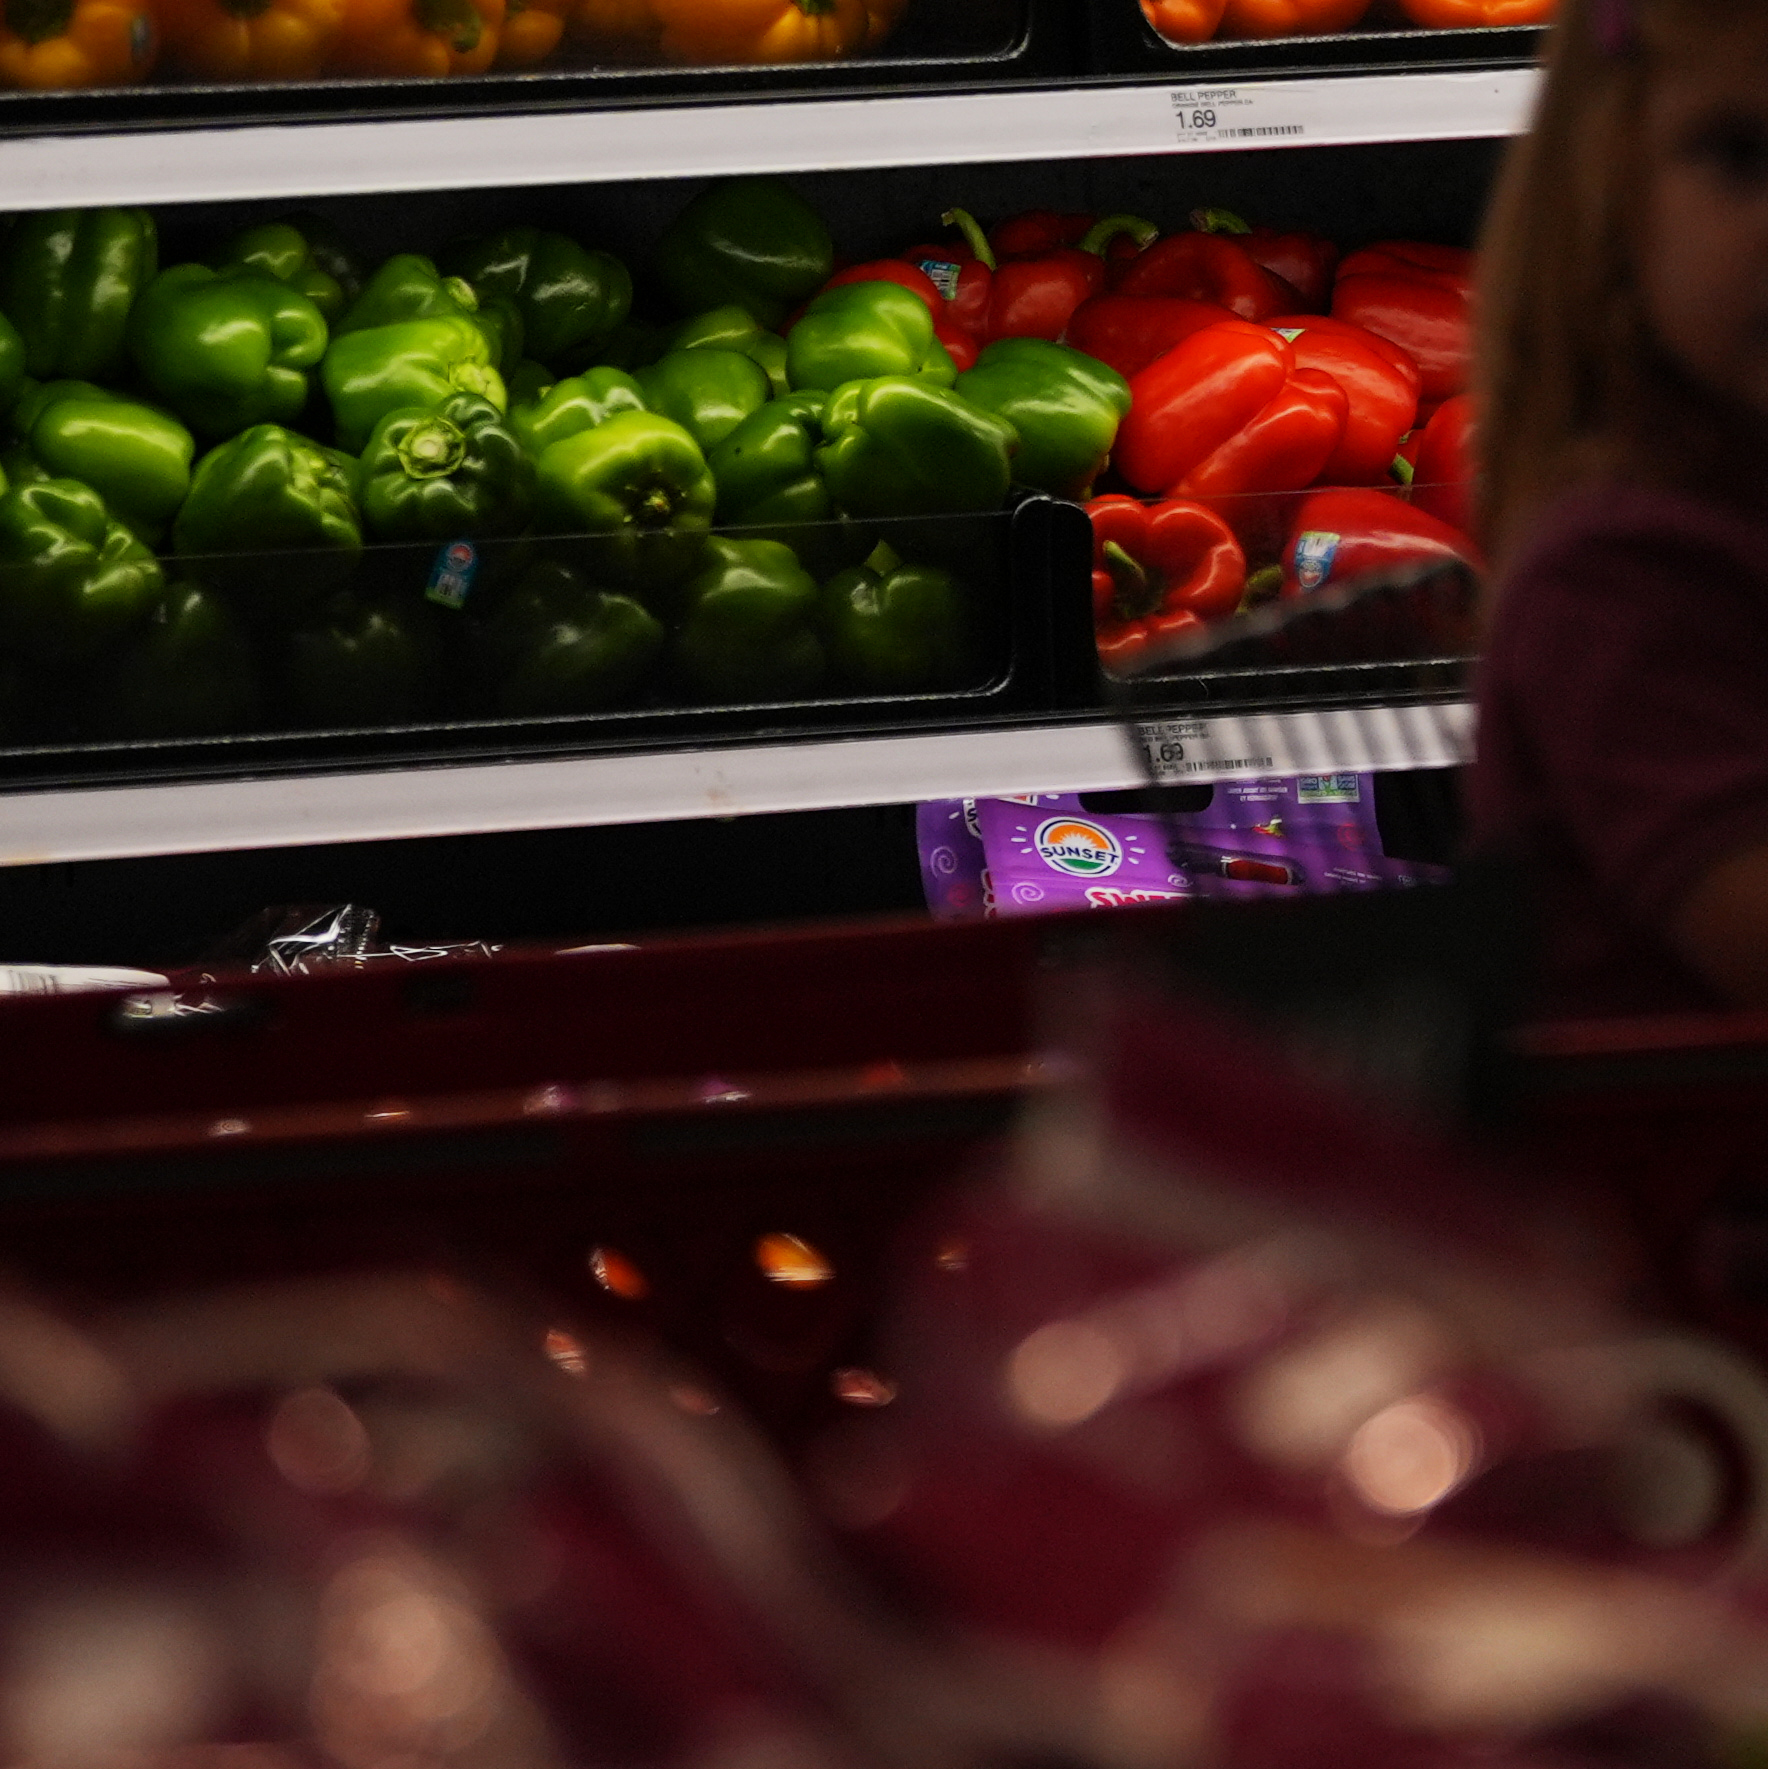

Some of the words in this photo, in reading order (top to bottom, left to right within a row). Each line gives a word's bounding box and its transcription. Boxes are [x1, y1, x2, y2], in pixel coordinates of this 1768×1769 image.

[1170, 91, 1195, 102] BELL
[1197, 89, 1237, 100] PEPPER
[1177, 109, 1217, 129] 1.69
[1168, 722, 1207, 735] PEPPER
[1143, 742, 1184, 763] 1.69
[1040, 843, 1120, 866] SUNSET
